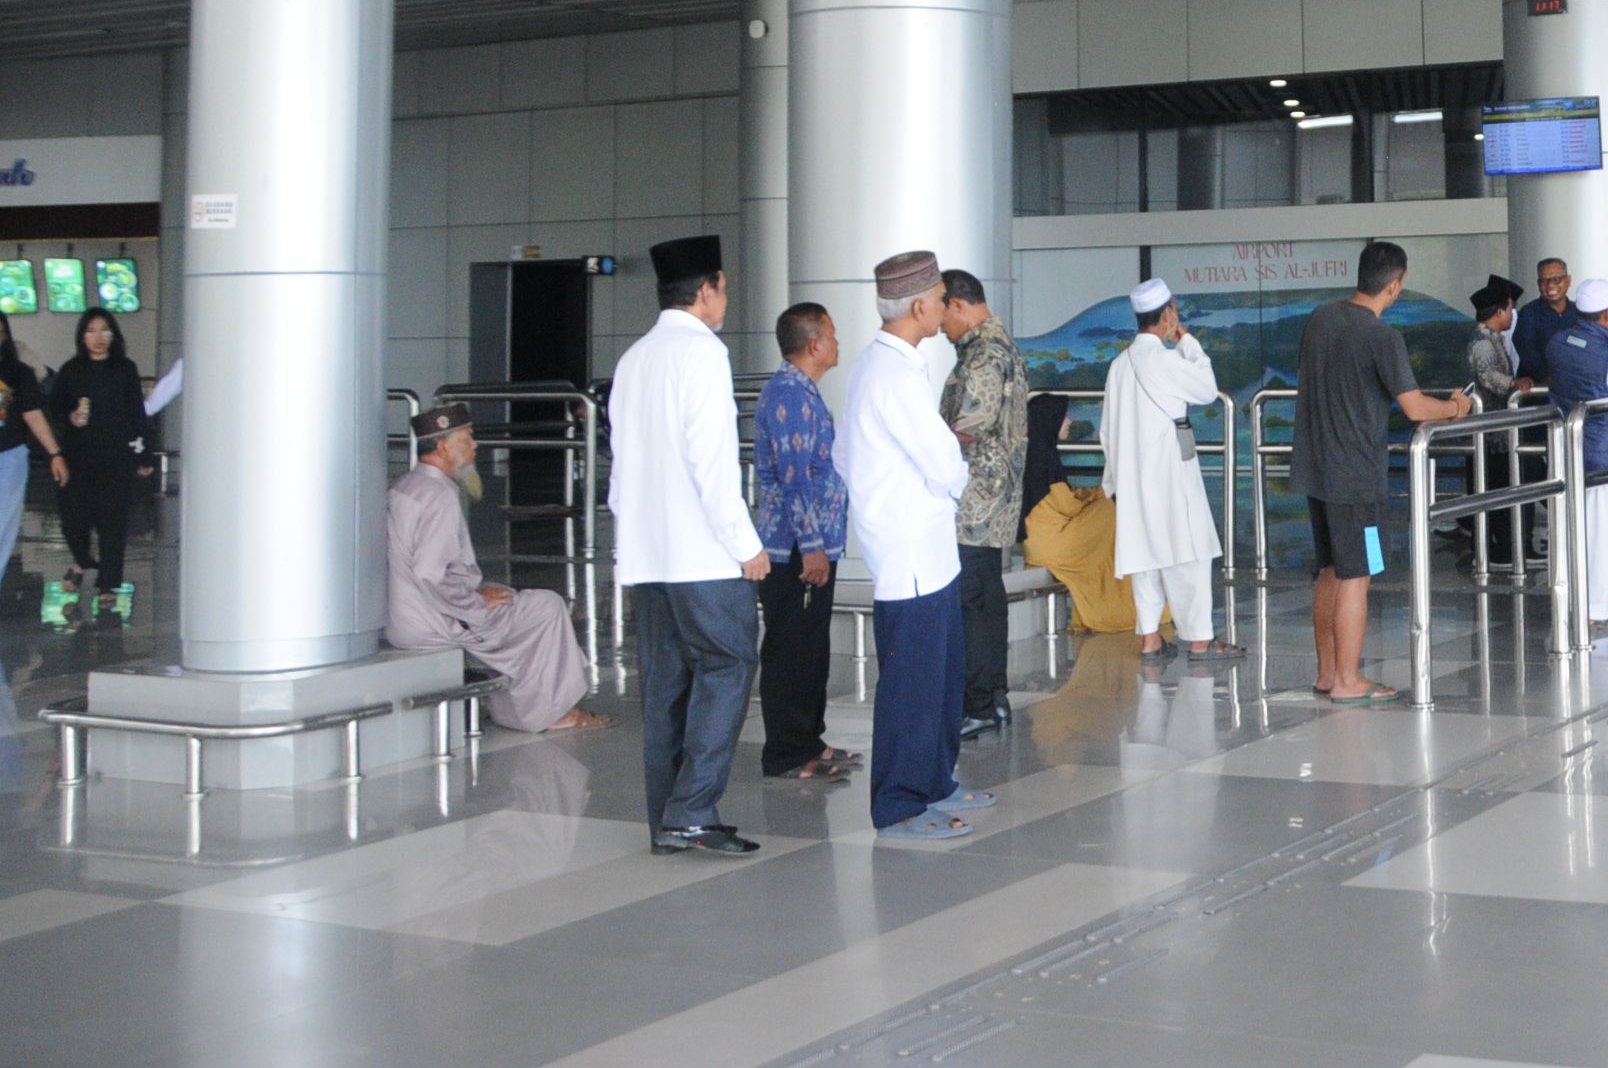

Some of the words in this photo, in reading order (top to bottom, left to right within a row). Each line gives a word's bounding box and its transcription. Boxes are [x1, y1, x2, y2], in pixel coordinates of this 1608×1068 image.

[1232, 241, 1295, 260] AIRPORT
[1184, 266, 1248, 283] MUTIARA
[1255, 263, 1277, 281] SIS
[1284, 260, 1347, 280] AL-JUFRI
